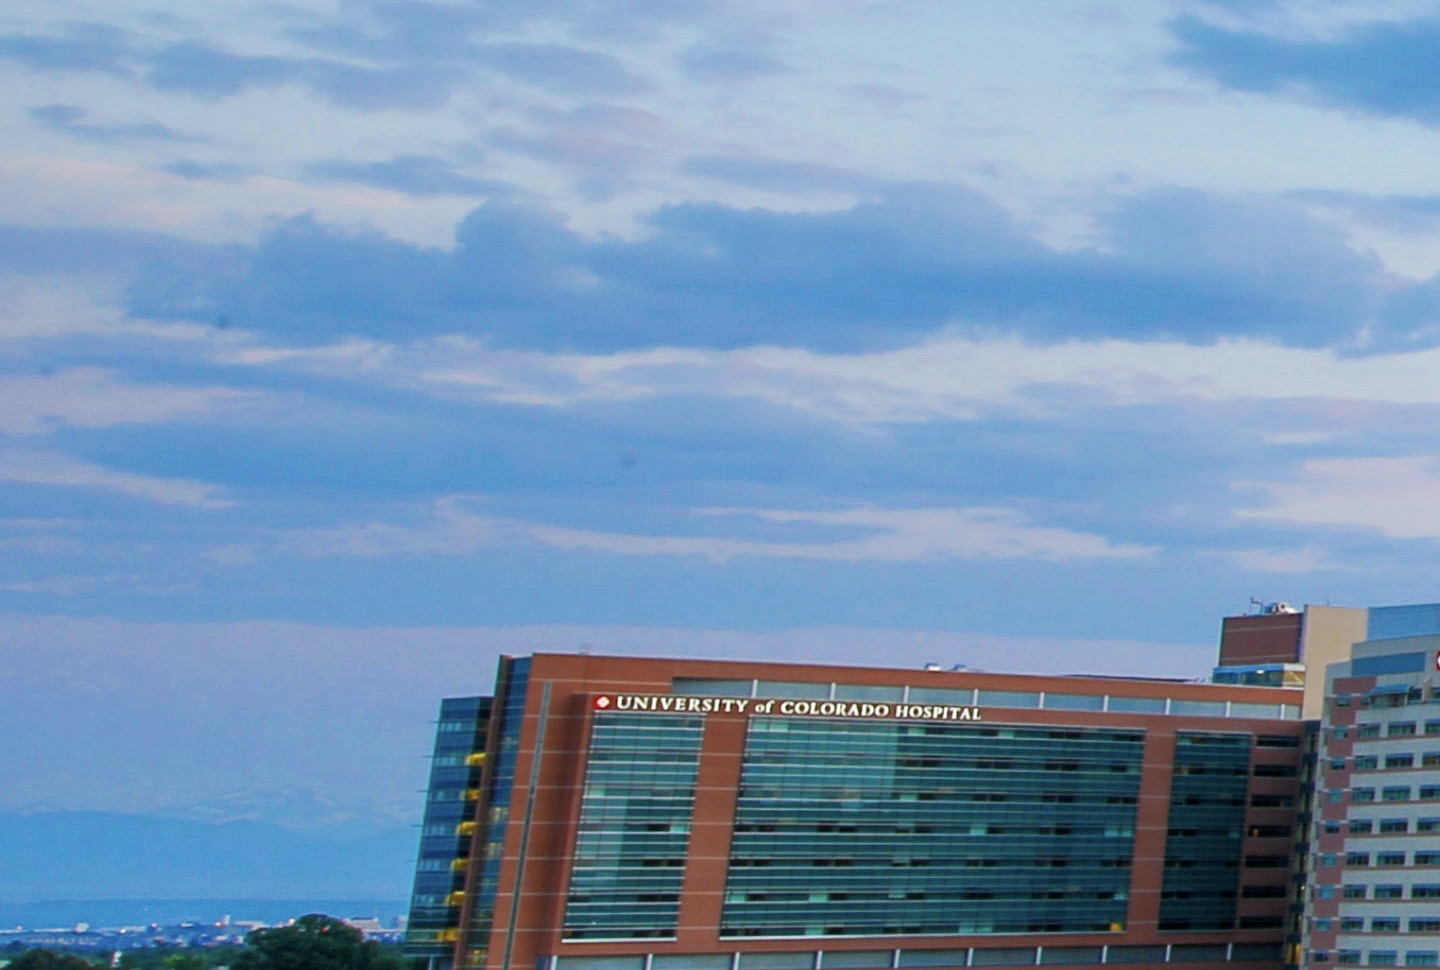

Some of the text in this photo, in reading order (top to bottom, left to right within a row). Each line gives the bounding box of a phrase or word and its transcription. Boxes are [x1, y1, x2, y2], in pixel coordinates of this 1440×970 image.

[616, 695, 982, 721] UNIVERSITY of COLORADO HOSPITAL
